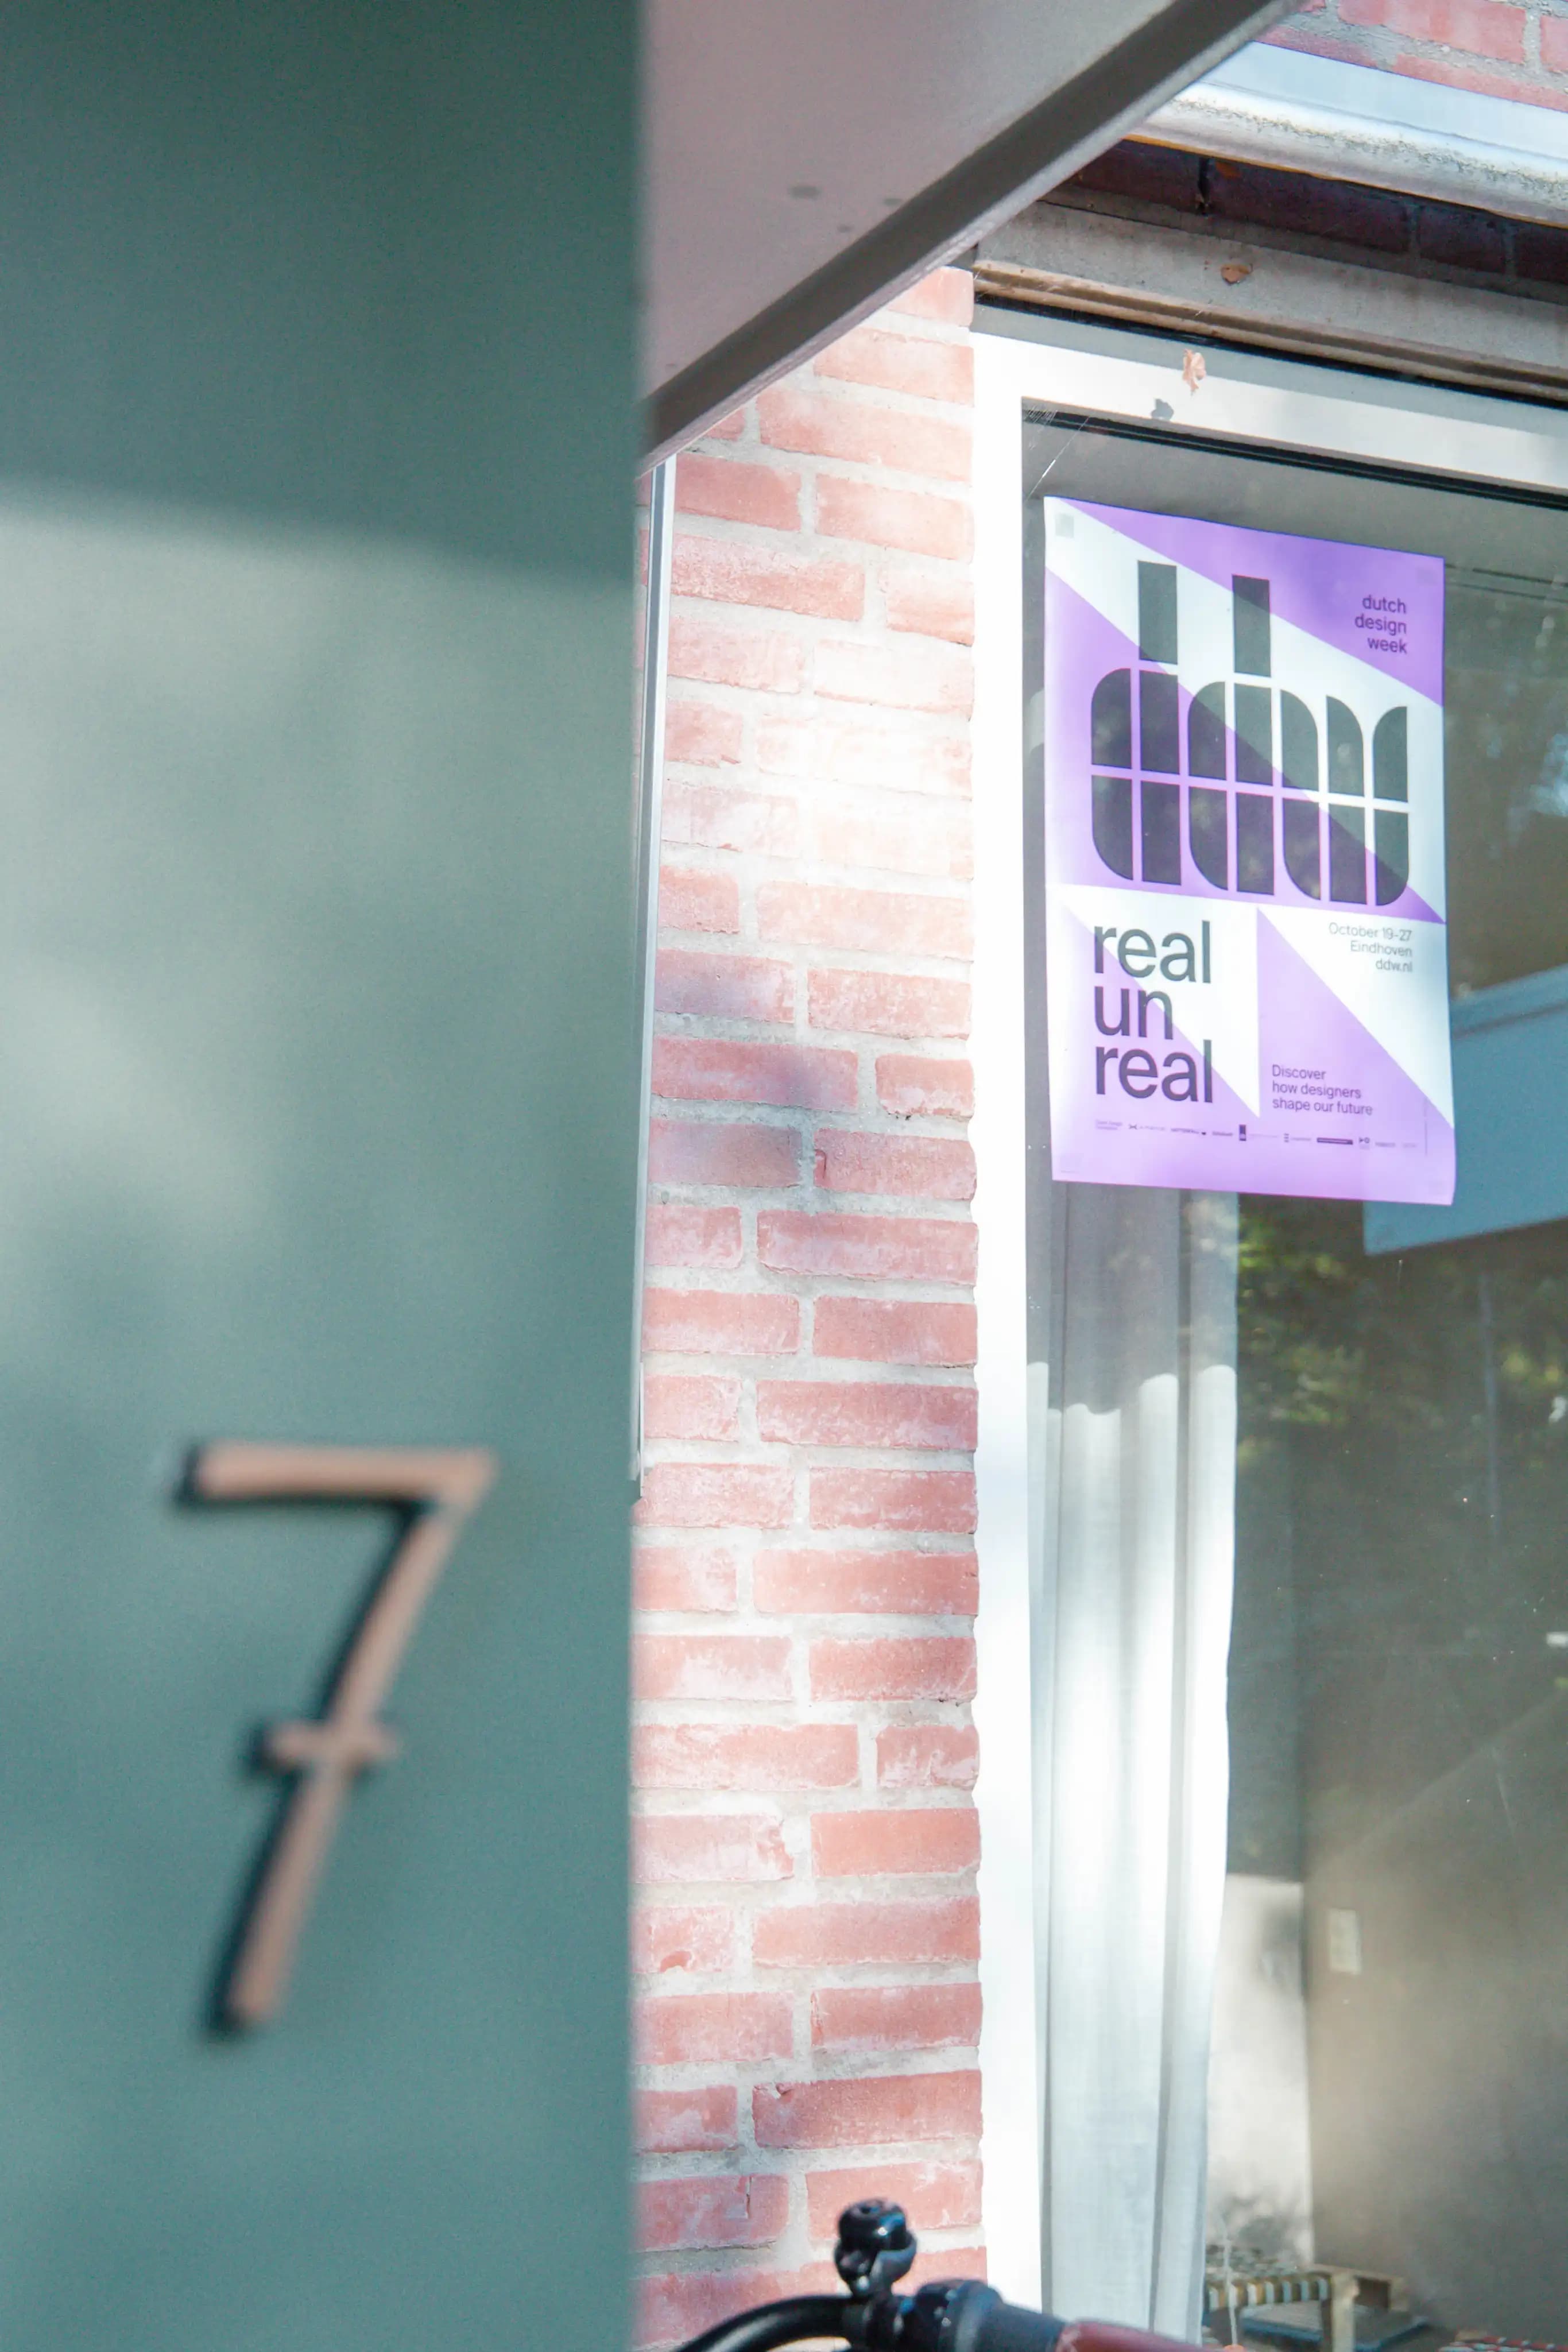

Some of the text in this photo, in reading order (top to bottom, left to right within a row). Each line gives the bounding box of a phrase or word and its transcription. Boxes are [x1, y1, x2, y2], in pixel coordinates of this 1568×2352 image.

[1362, 594, 1406, 614] dutch
[1354, 613, 1406, 636] design
[1367, 637, 1407, 654] week
[1329, 922, 1412, 942] October 19-27
[1093, 920, 1211, 984] real
[1350, 940, 1412, 957] Eindhoven
[1375, 958, 1413, 973] ddw.nl
[1094, 985, 1174, 1040] un
[1095, 1039, 1213, 1103] real
[1272, 1064, 1326, 1080] Discover
[1272, 1080, 1362, 1099] how designers
[1272, 1097, 1373, 1116] shape our future
[192, 1438, 498, 2027] 7
